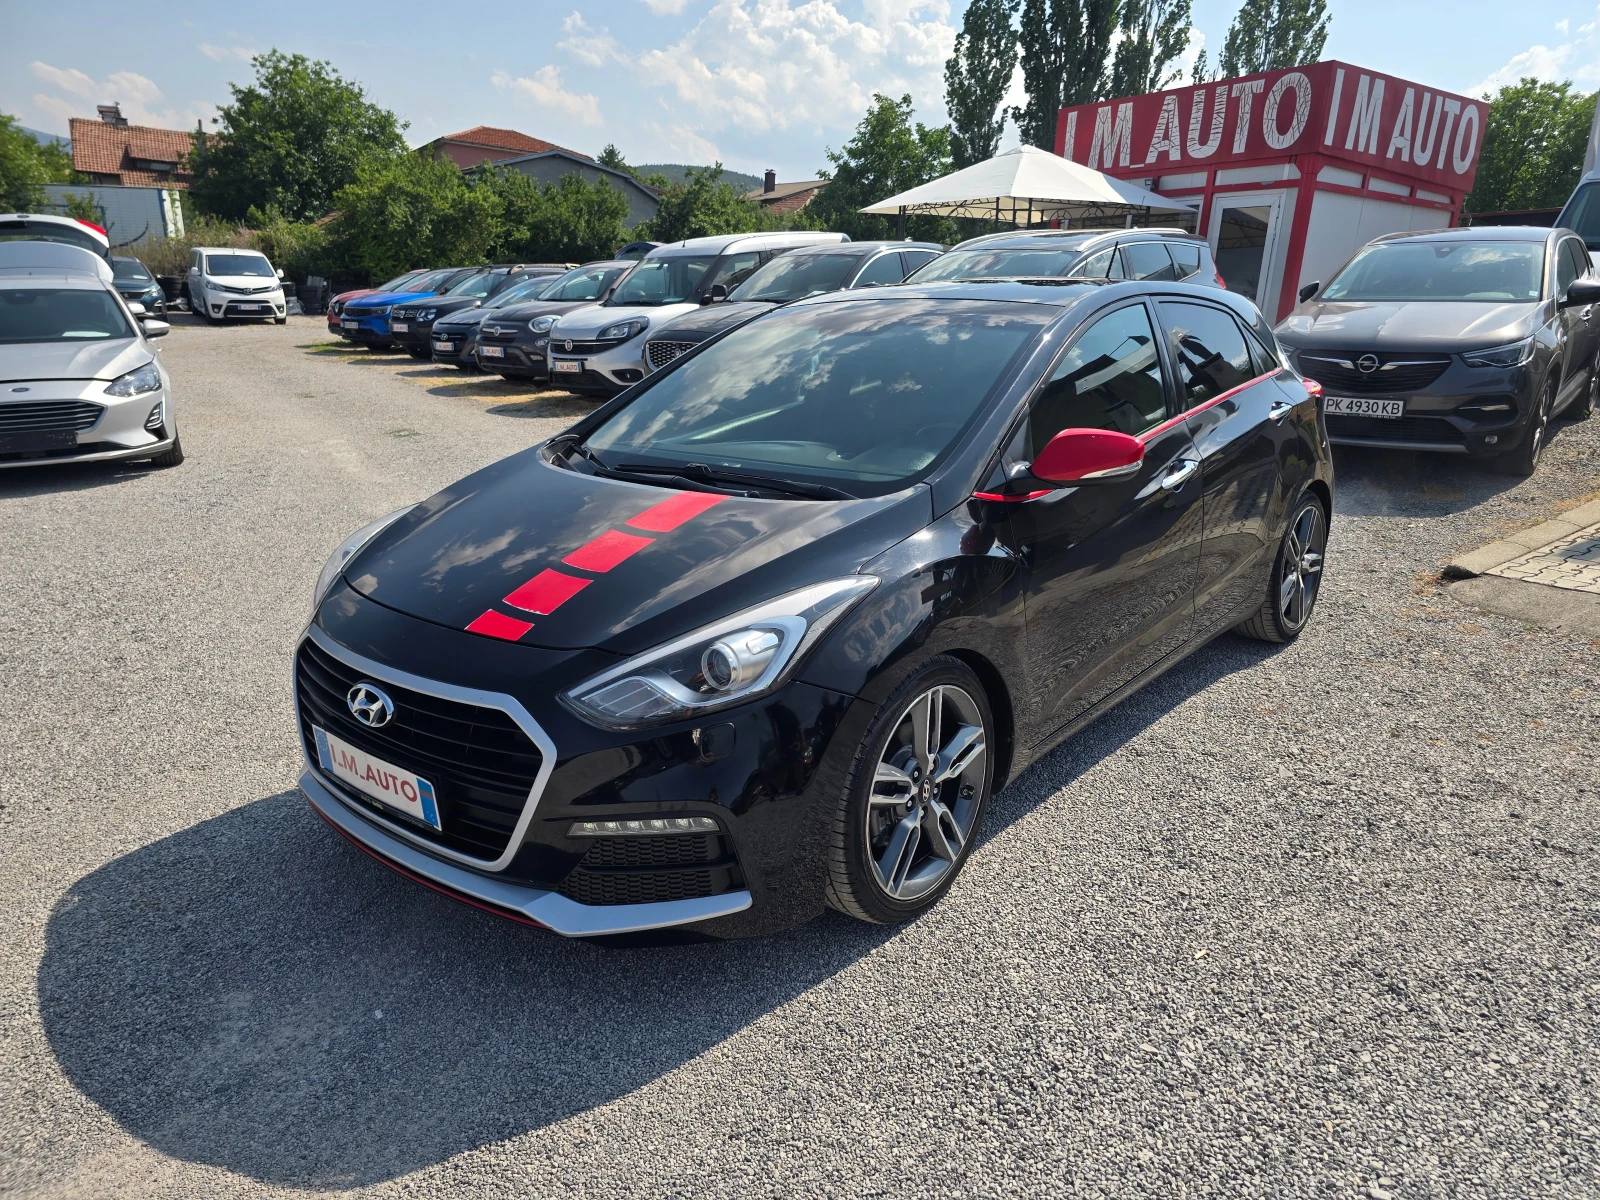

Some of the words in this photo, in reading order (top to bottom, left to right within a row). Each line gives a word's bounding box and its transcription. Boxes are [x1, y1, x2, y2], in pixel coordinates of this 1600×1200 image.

[1324, 68, 1345, 146] I
[1344, 74, 1386, 155] M
[1386, 87, 1480, 175] AUTO
[1325, 398, 1343, 411] PK
[1345, 400, 1379, 413] 4930
[1381, 402, 1400, 415] KB
